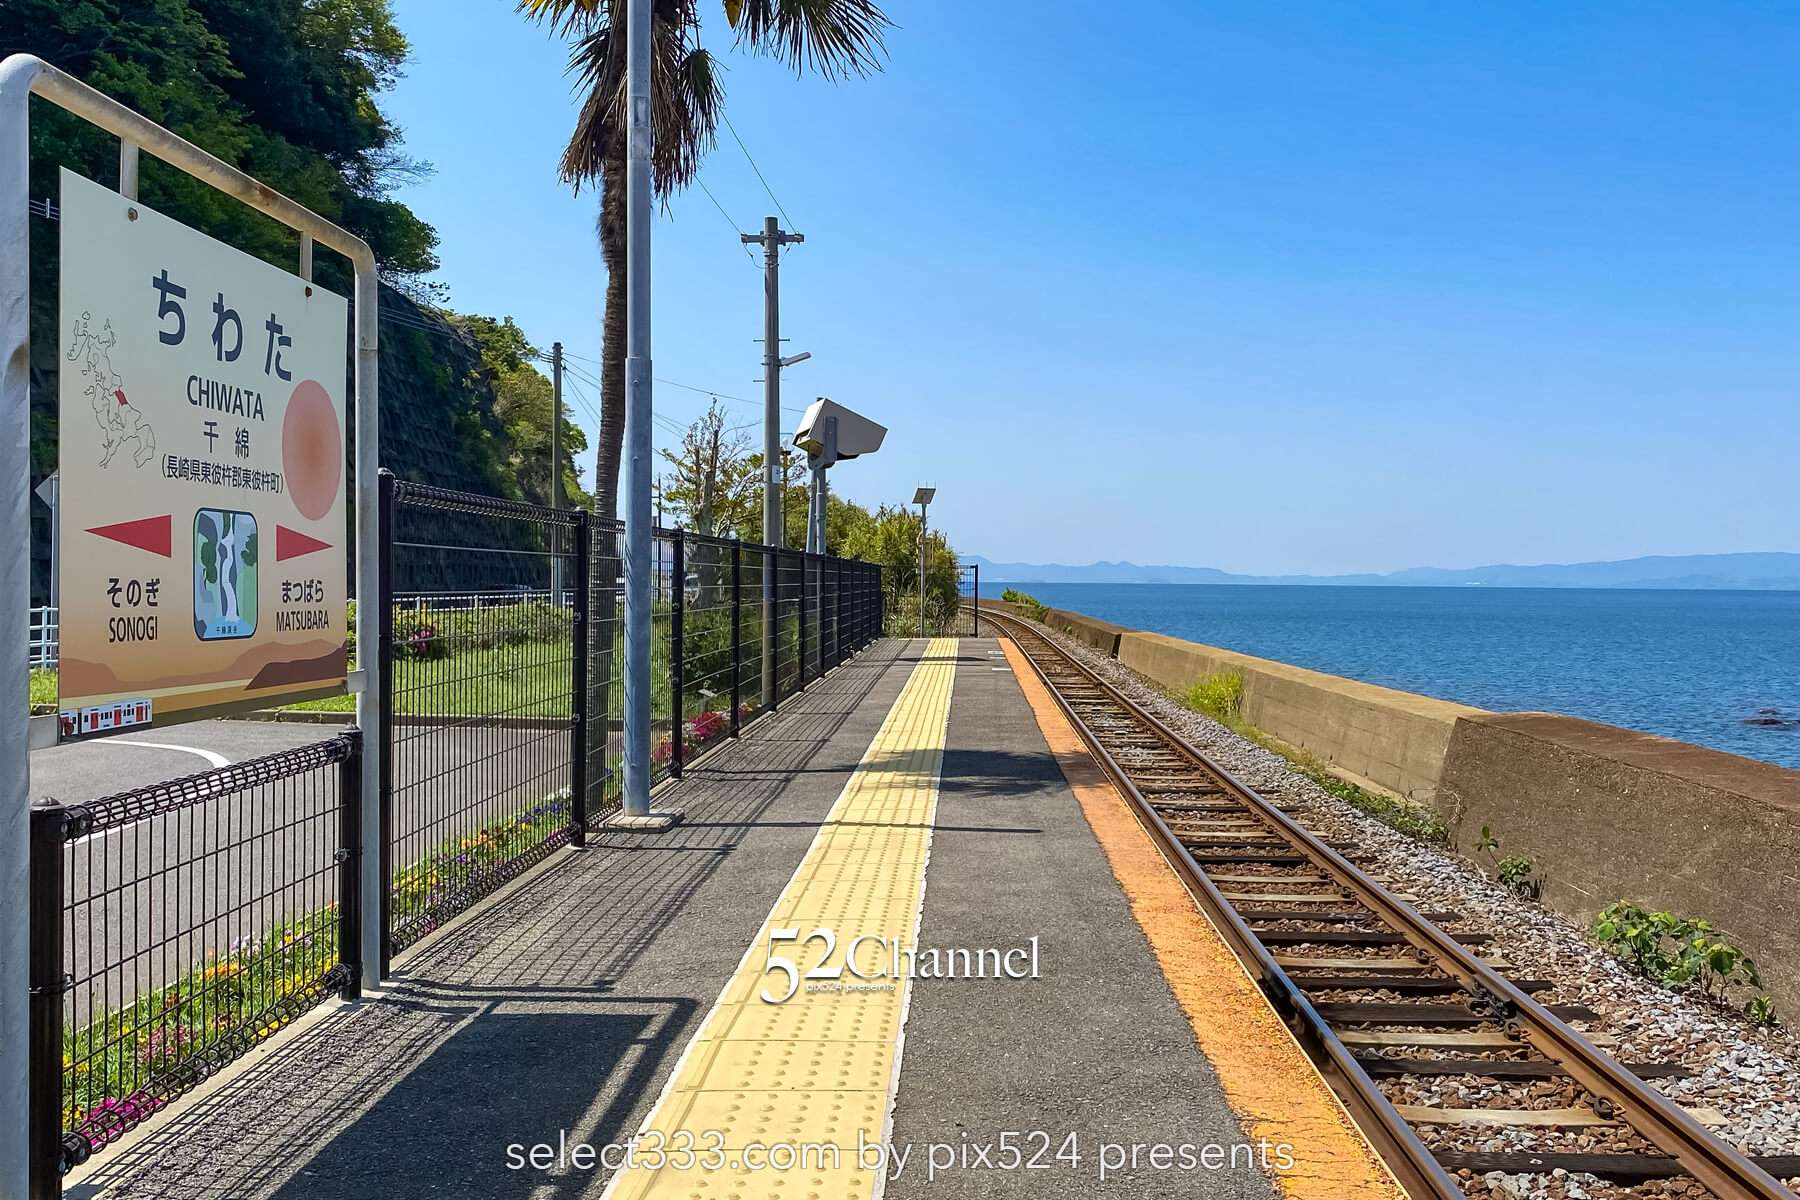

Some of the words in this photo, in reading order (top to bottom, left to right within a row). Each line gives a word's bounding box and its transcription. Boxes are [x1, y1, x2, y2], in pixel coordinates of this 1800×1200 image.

[152, 269, 293, 382] ちわた
[187, 374, 265, 421] CHIWATA
[203, 421, 249, 459] 千綿
[106, 577, 161, 608] そのぎ
[281, 579, 324, 604] まつばら
[108, 615, 159, 643] SONOGI
[276, 610, 330, 633] MATSUBARA
